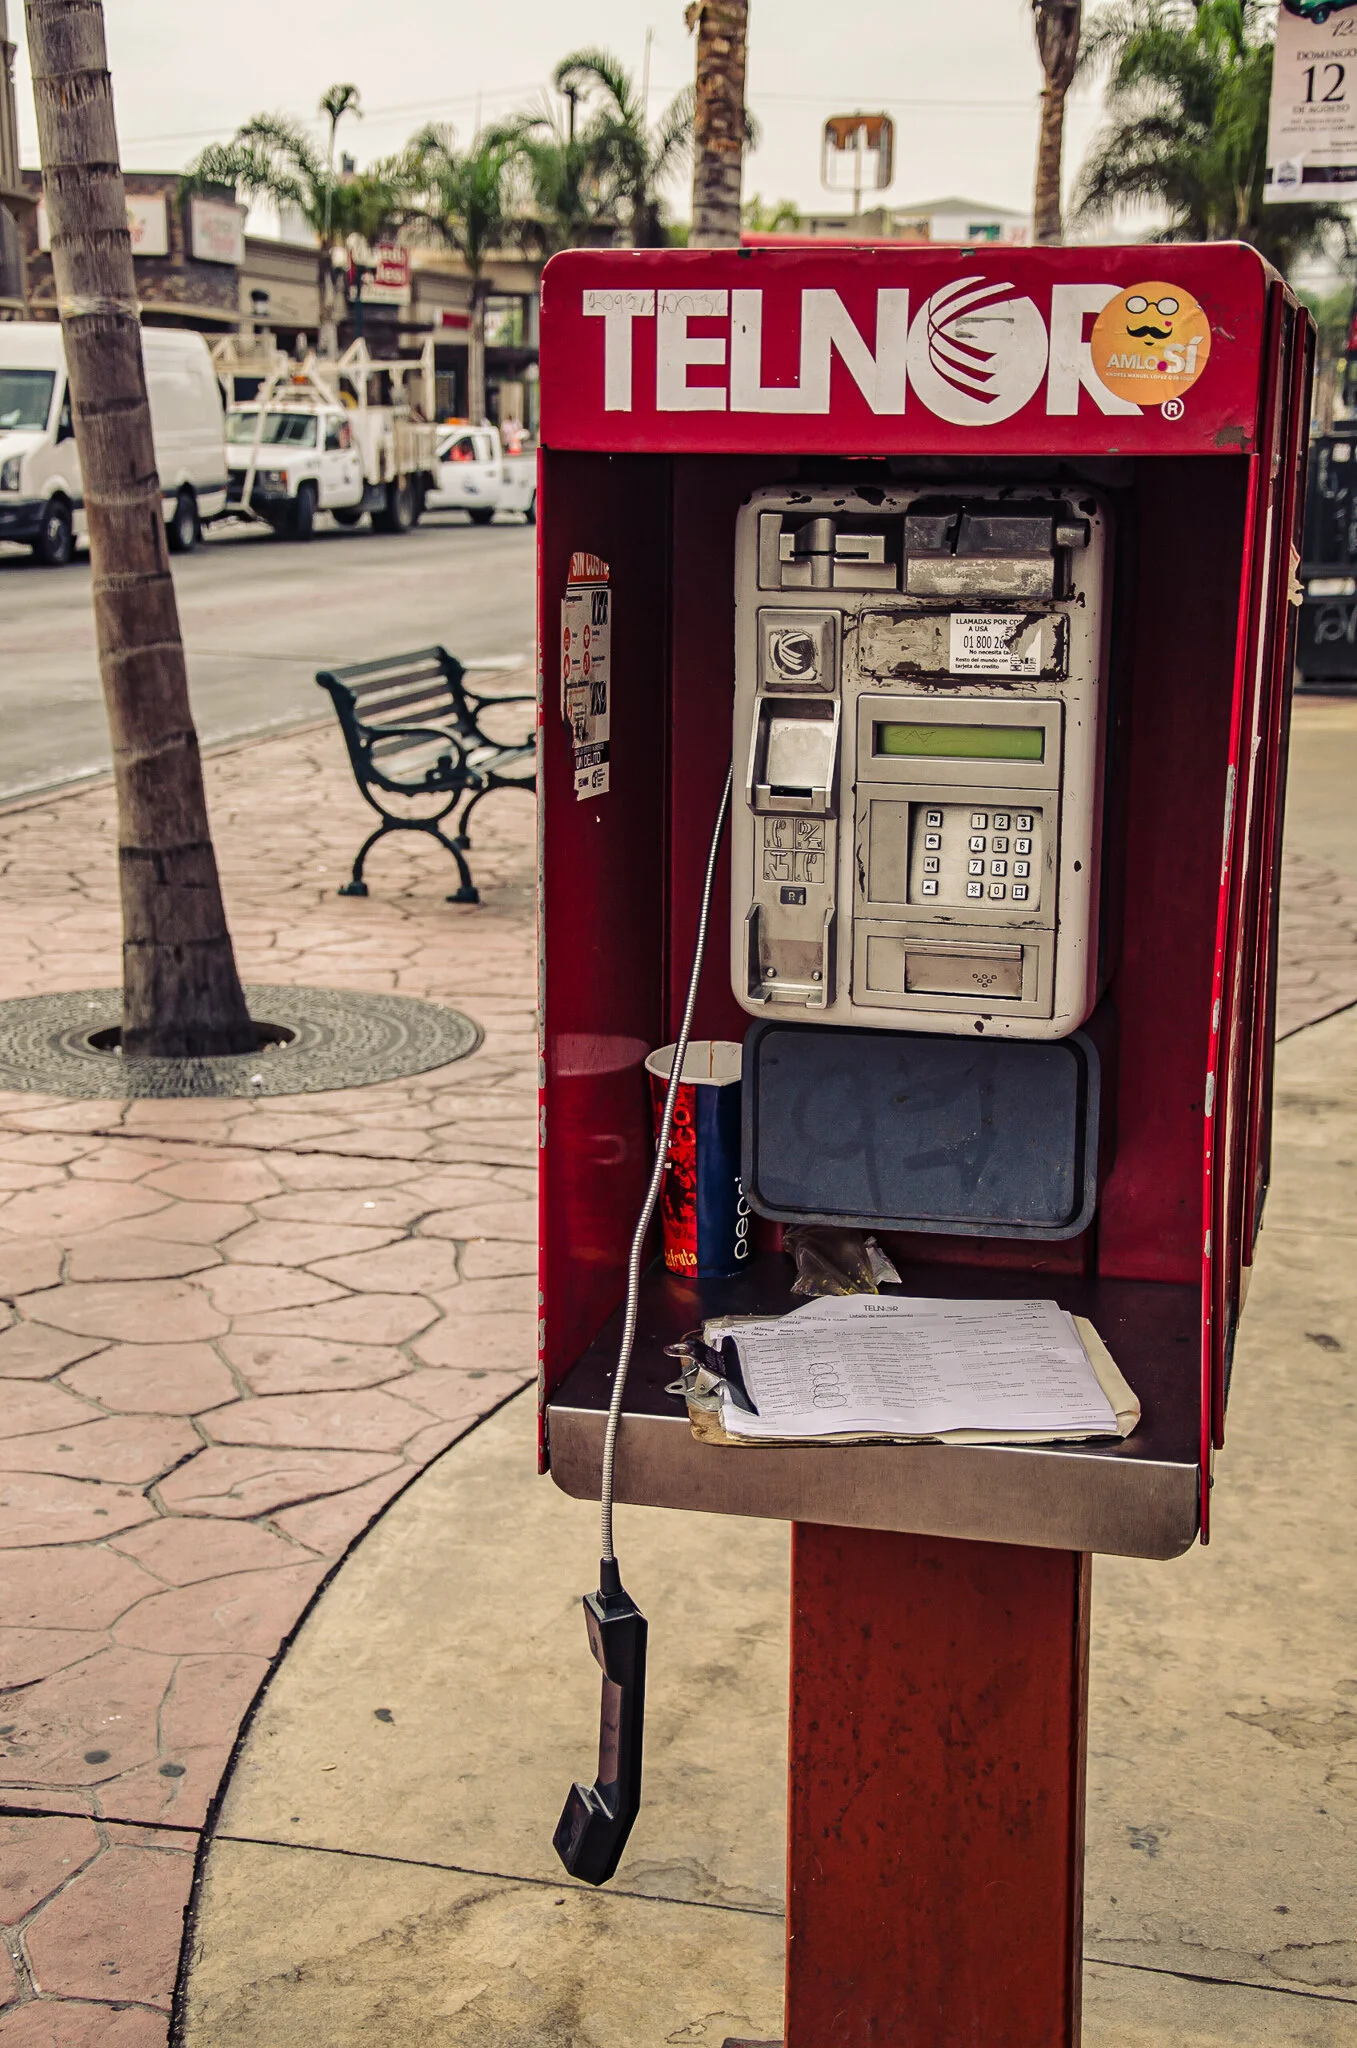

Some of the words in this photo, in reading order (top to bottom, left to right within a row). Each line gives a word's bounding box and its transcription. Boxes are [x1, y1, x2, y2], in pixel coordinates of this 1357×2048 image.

[1297, 48, 1357, 60] DOMINGO
[1302, 63, 1346, 102] 12
[582, 276, 1144, 426] TELNOR
[573, 552, 585, 576] SIN
[963, 636, 974, 648] 01
[976, 636, 992, 649] 800
[998, 818, 1005, 827] 2
[1020, 818, 1027, 827] 3
[974, 840, 980, 848] 4
[997, 840, 1003, 848] 5
[1019, 841, 1025, 850] 6
[972, 863, 978, 871] 7
[995, 863, 1001, 872] 8
[1018, 865, 1024, 873] 9
[994, 887, 999, 895] 0
[788, 892, 796, 901] R
[864, 1304, 899, 1312] TELNOR
